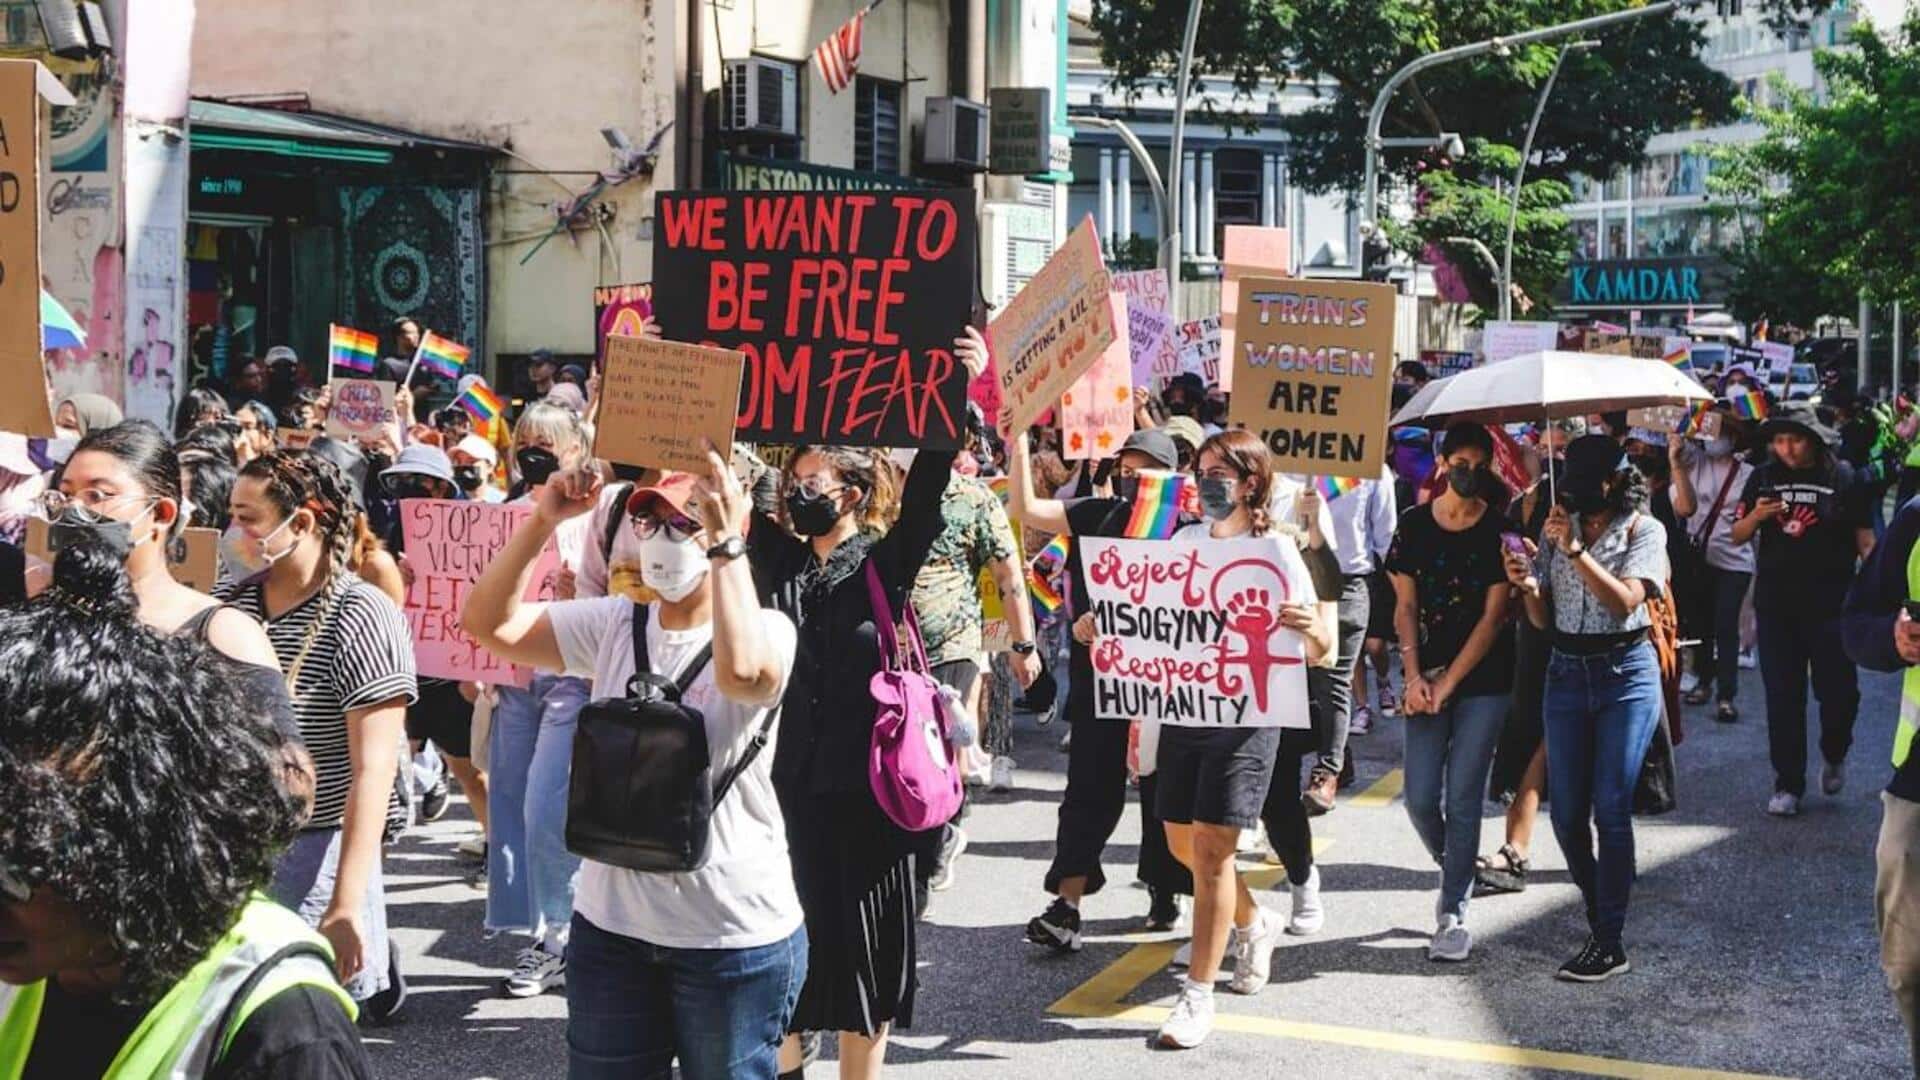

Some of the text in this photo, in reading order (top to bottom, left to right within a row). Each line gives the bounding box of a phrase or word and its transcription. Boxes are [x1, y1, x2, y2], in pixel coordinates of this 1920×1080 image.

[662, 195, 958, 262] WE WANT TO
[706, 257, 912, 346] BE FREE
[1573, 266, 1701, 301] KAMDAR
[1250, 291, 1370, 328] TRANS
[1243, 340, 1376, 379] WOMEN
[703, 340, 813, 434] OM
[818, 348, 958, 440] FEAR
[1268, 380, 1342, 417] ARE
[413, 502, 482, 546] STOP
[1090, 545, 1210, 607] Reject
[1090, 597, 1228, 651] MISOGYNY
[1095, 635, 1243, 697] Respect
[1098, 677, 1249, 725] HUMANITY
